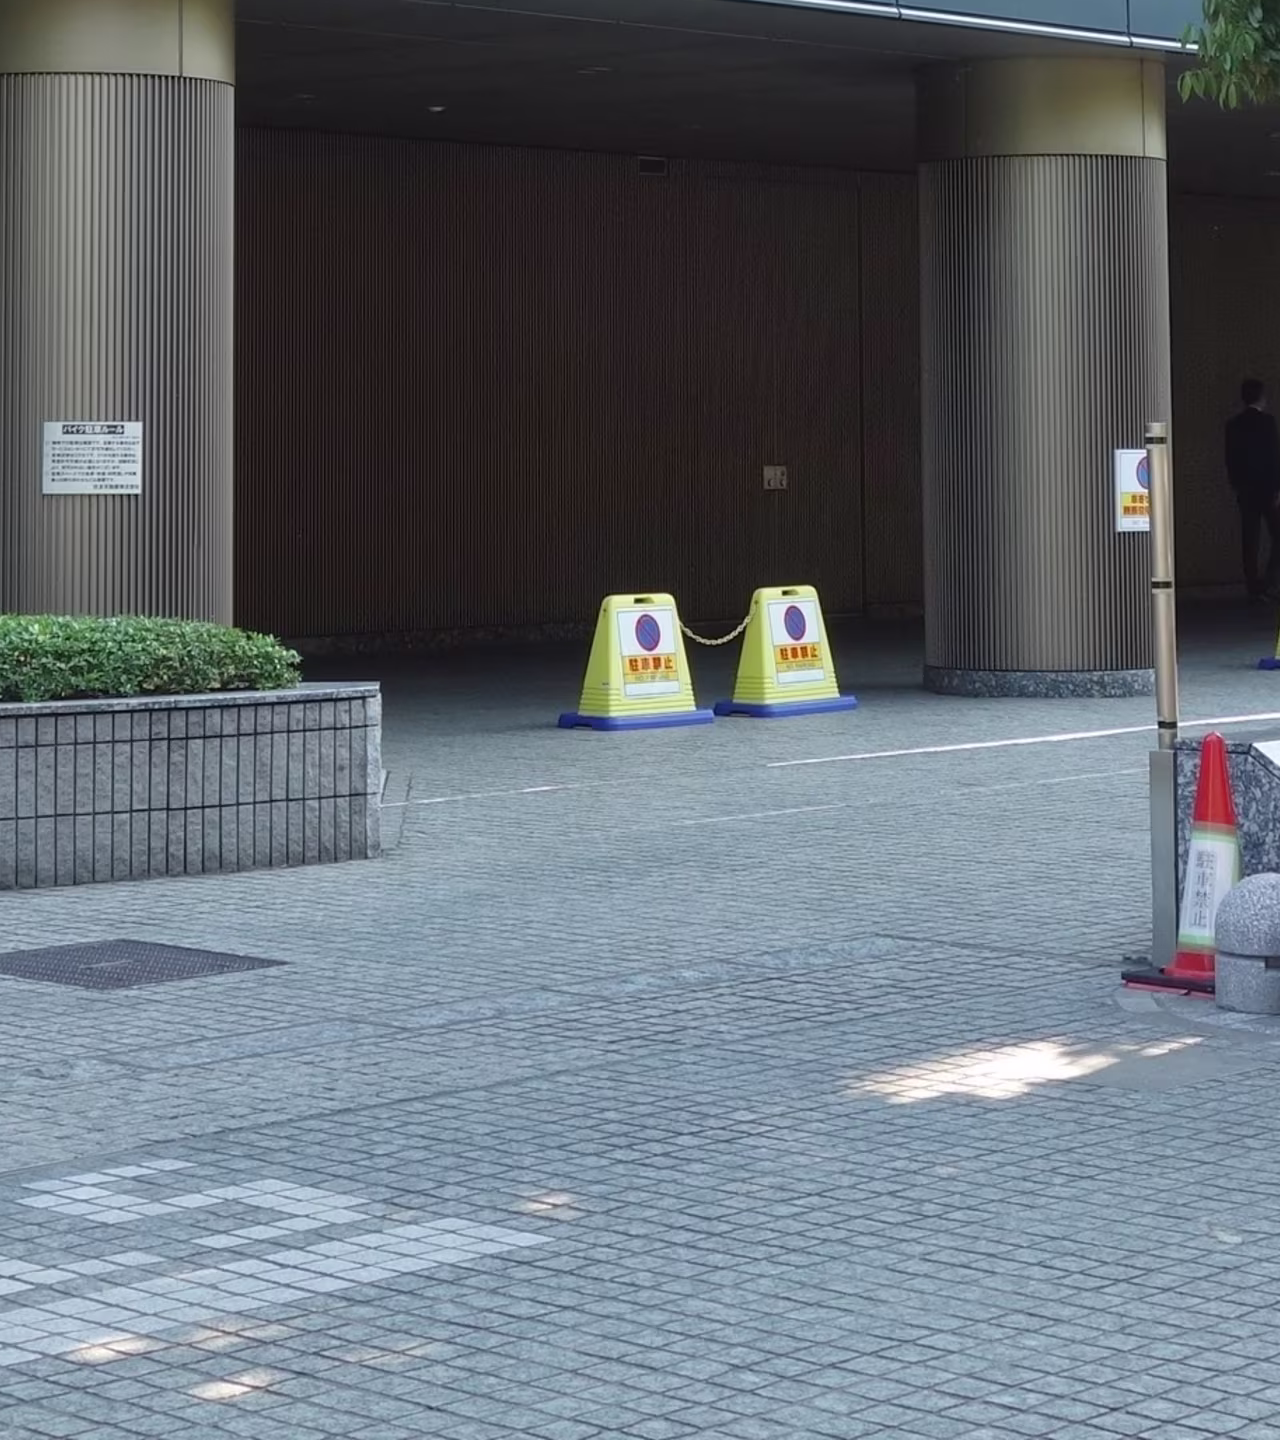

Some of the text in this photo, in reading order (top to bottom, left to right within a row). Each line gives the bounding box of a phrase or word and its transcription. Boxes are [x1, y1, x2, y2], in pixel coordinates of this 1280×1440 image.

[780, 644, 818, 660] 駐車禁止
[628, 655, 673, 671] 駐車禁止
